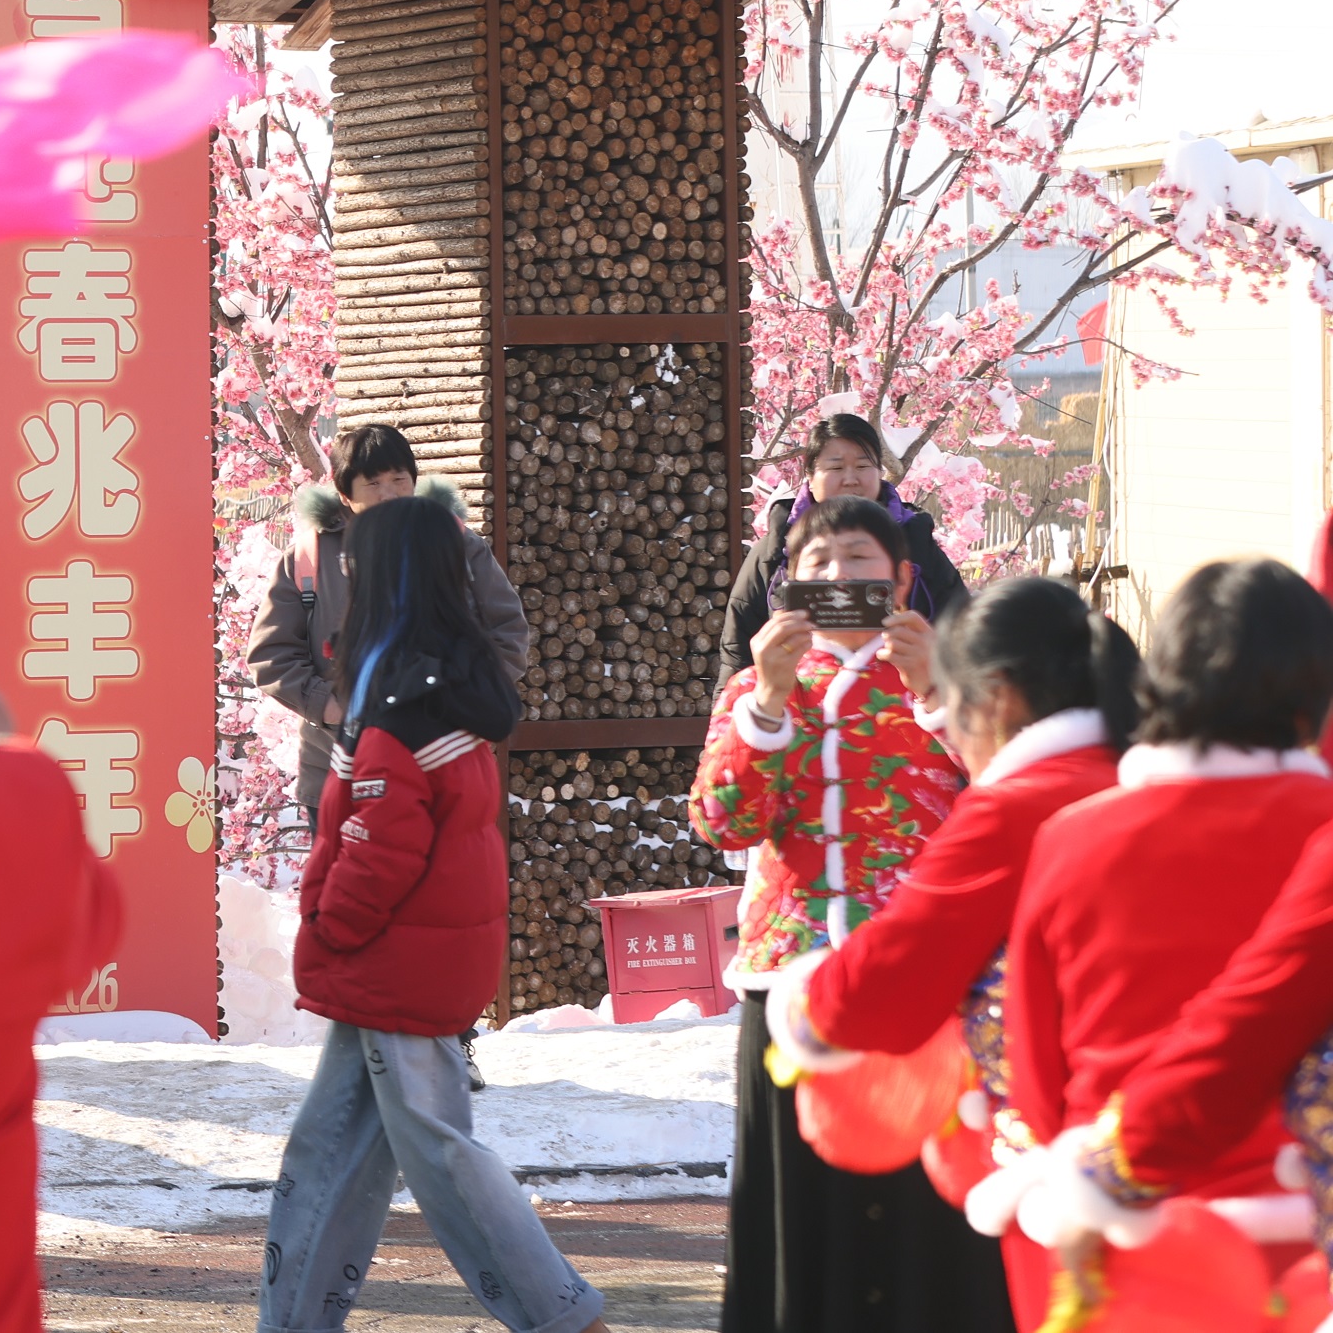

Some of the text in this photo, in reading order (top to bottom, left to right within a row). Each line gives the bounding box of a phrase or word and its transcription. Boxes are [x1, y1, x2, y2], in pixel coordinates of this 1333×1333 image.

[626, 933, 695, 954] 灭火器箱
[627, 956, 696, 968] FIRE EXTINGUISHER BOX
[46, 961, 119, 1014] 26
